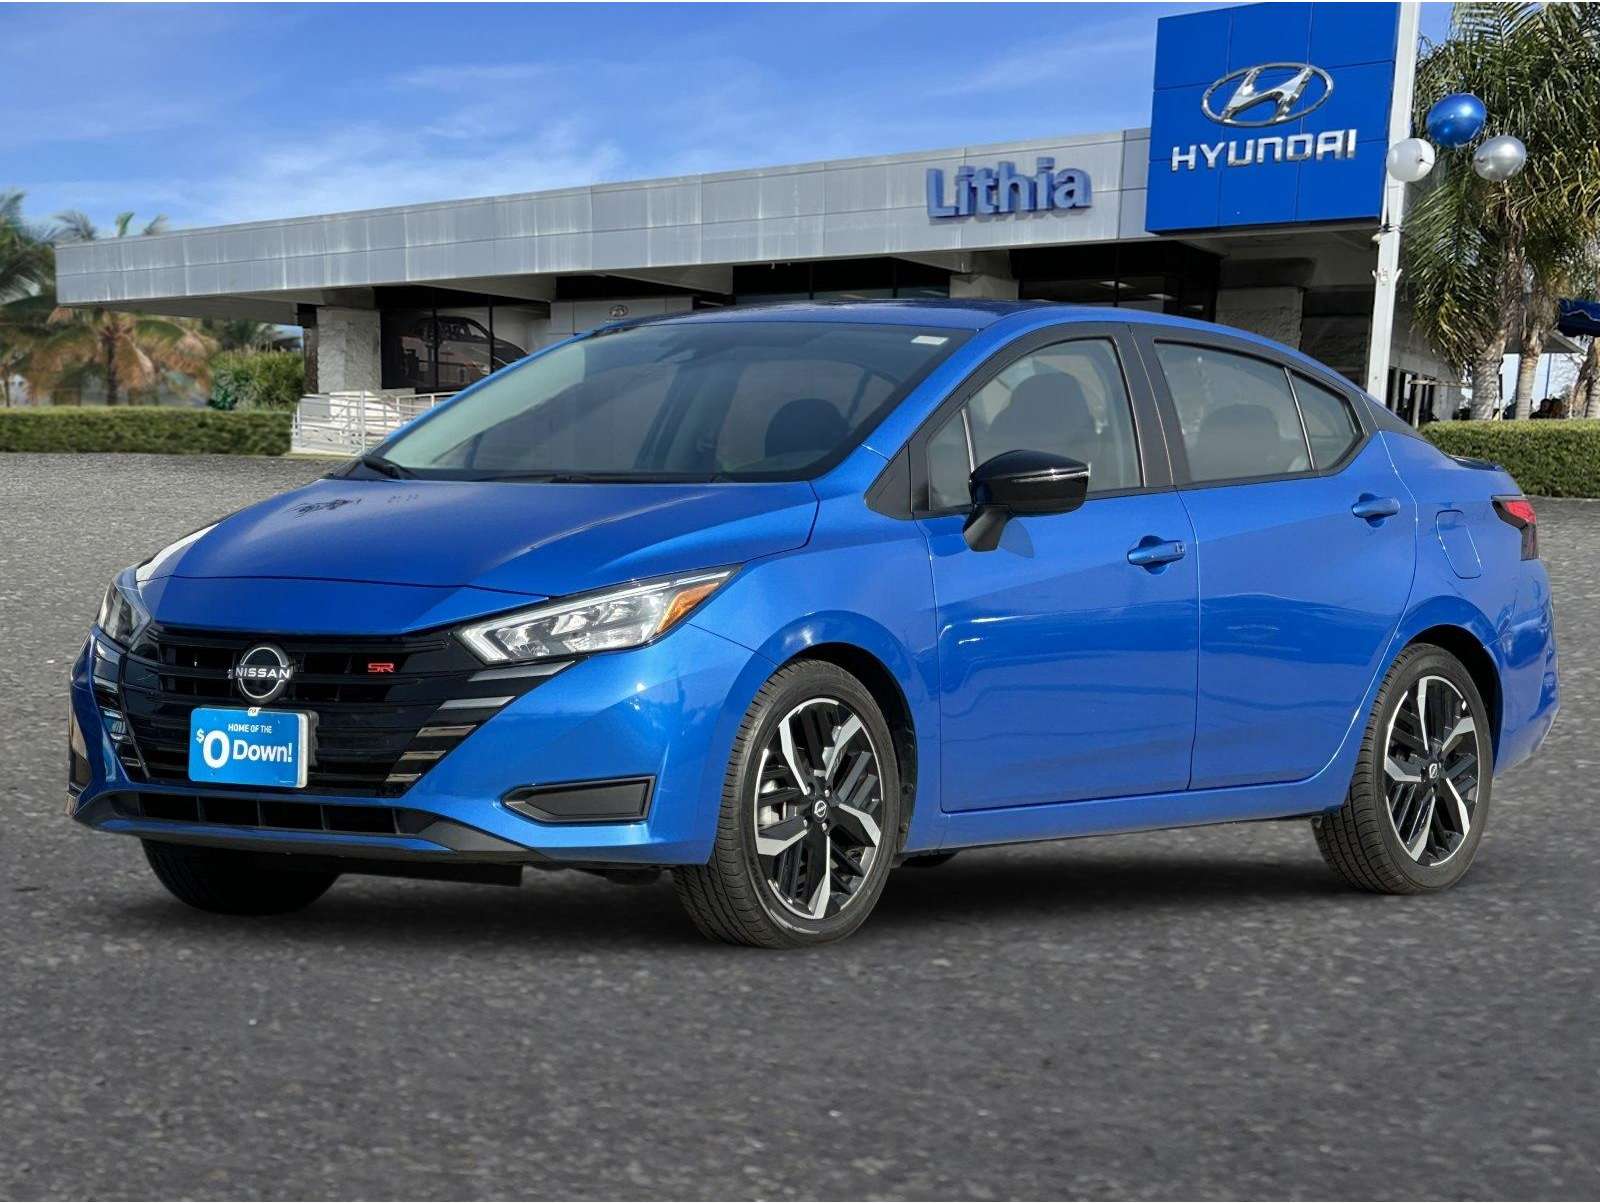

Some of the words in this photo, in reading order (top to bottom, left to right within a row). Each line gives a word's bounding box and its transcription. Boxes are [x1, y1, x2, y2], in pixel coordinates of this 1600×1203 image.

[1171, 128, 1357, 172] HYUNDAI
[926, 156, 1092, 218] Lithia
[235, 667, 291, 679] NISSAN
[367, 662, 395, 673] SR
[228, 723, 250, 734] HOME
[250, 724, 260, 734] OF
[261, 725, 273, 735] THE
[232, 739, 293, 763] Down!
